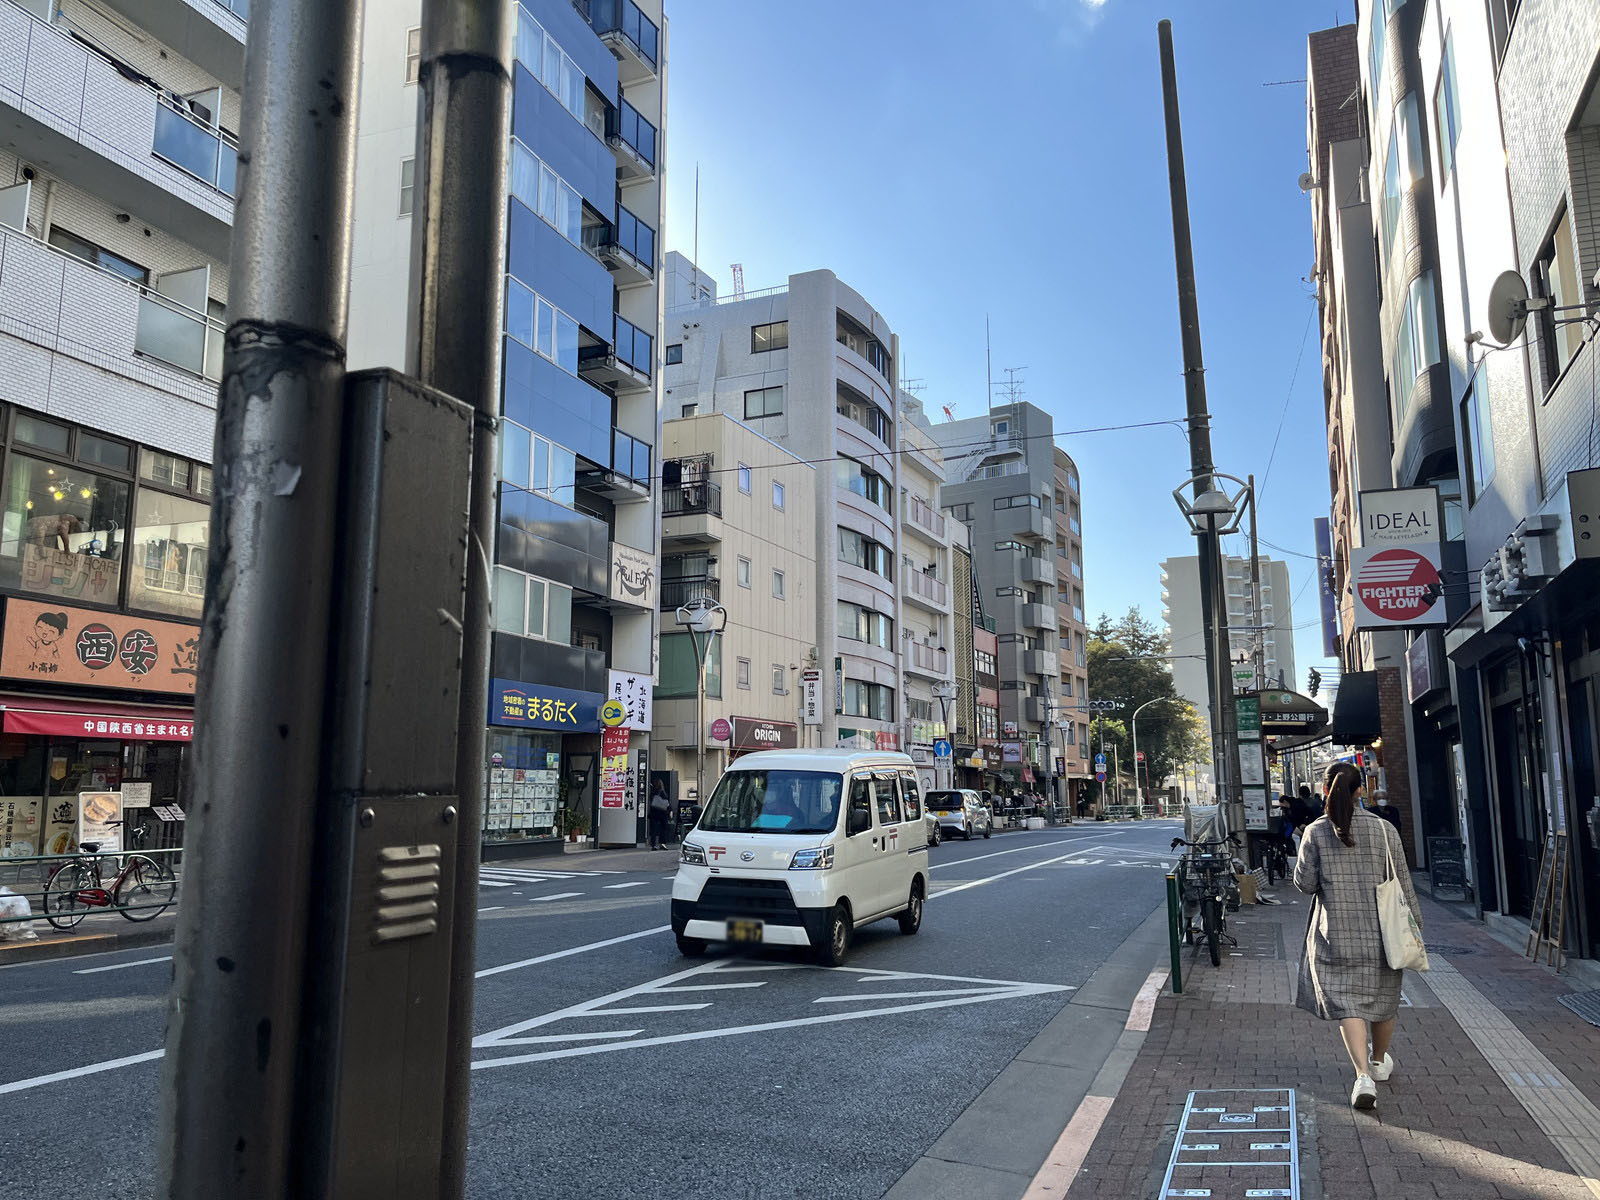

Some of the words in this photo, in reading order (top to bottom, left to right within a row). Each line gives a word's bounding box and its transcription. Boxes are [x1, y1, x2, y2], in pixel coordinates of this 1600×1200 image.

[1369, 511, 1431, 530] IDEAL
[1379, 597, 1420, 610] FLOW
[77, 630, 158, 675] 西安
[527, 696, 578, 724] まるたく
[638, 685, 646, 723] 北海道
[754, 728, 781, 742] ORIGIN
